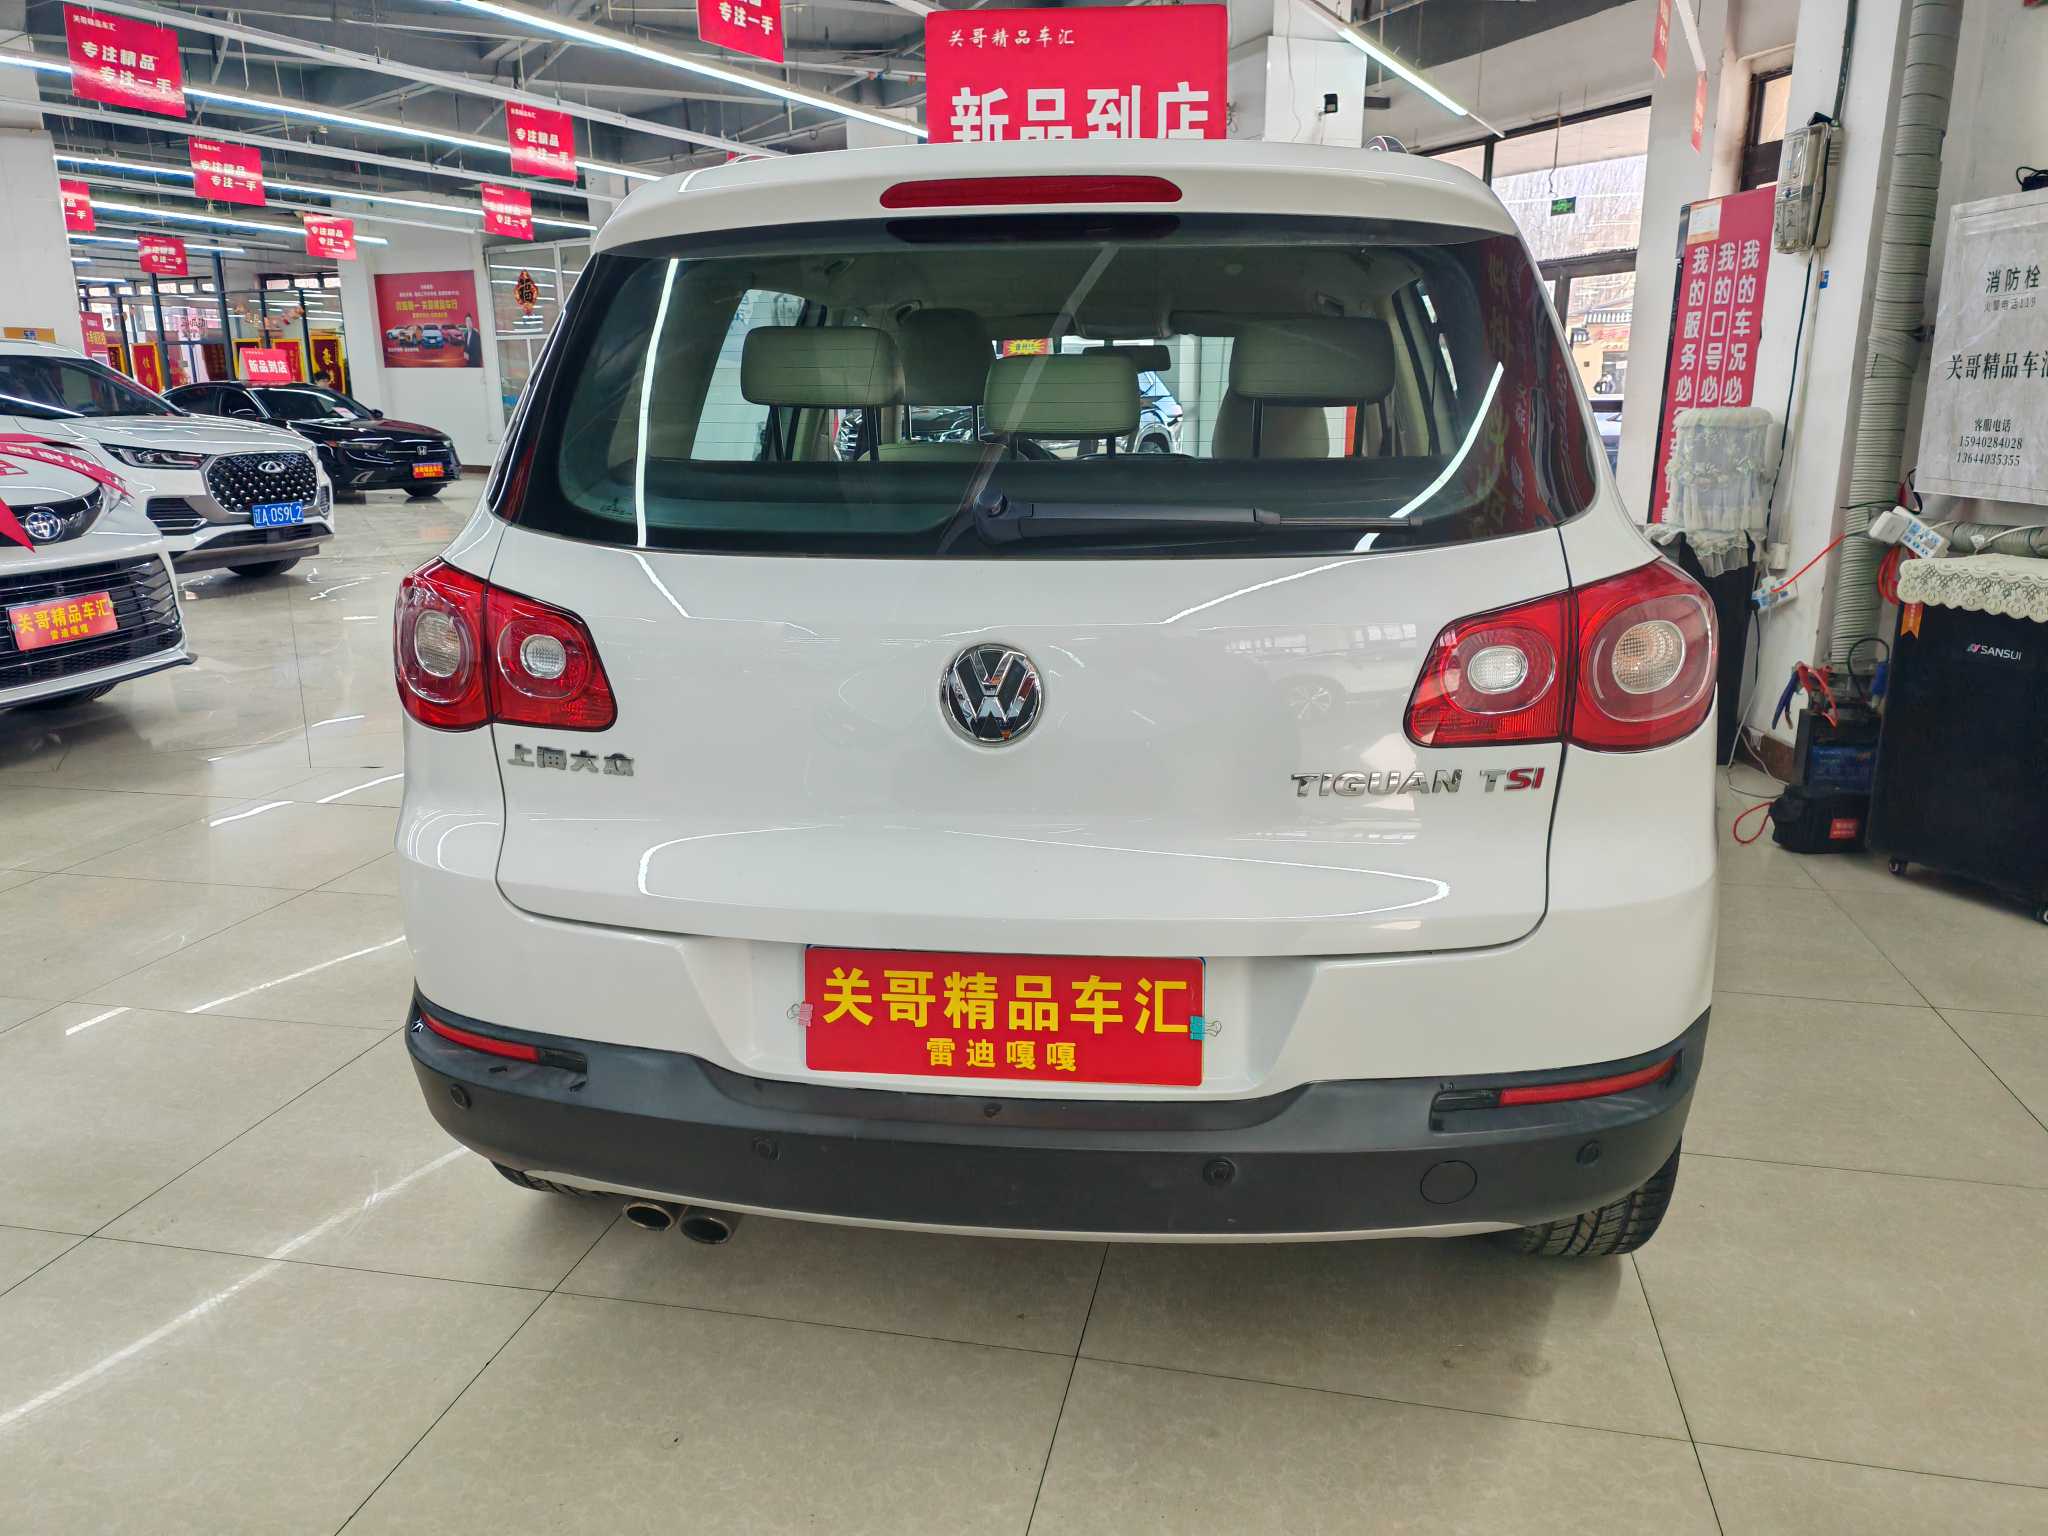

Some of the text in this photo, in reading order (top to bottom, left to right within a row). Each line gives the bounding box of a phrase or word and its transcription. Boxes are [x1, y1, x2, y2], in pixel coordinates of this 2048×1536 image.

[718, 1, 774, 35] 专注一手
[948, 26, 1075, 48] 关哥精品车汇
[81, 41, 157, 71] 专注精品
[99, 66, 172, 93] 专注一手
[950, 81, 1209, 143] 新品到店
[1985, 264, 2041, 294] 消防栓
[1700, 242, 1736, 403] 我的口号必
[1724, 239, 1760, 404] 我的车况必
[249, 359, 288, 374] 新品到店
[1974, 418, 2013, 433] 客服电话
[1959, 435, 2023, 450] 15940284028
[1956, 451, 2021, 467] 13644035355
[18, 598, 112, 634] 关哥精品车汇
[1980, 645, 2022, 660] SANSUI
[1291, 767, 1545, 797] TIGUAN TSI
[823, 967, 1191, 1034] 关哥精品车汇
[926, 1037, 1077, 1072] 雷迪嘎嘎
